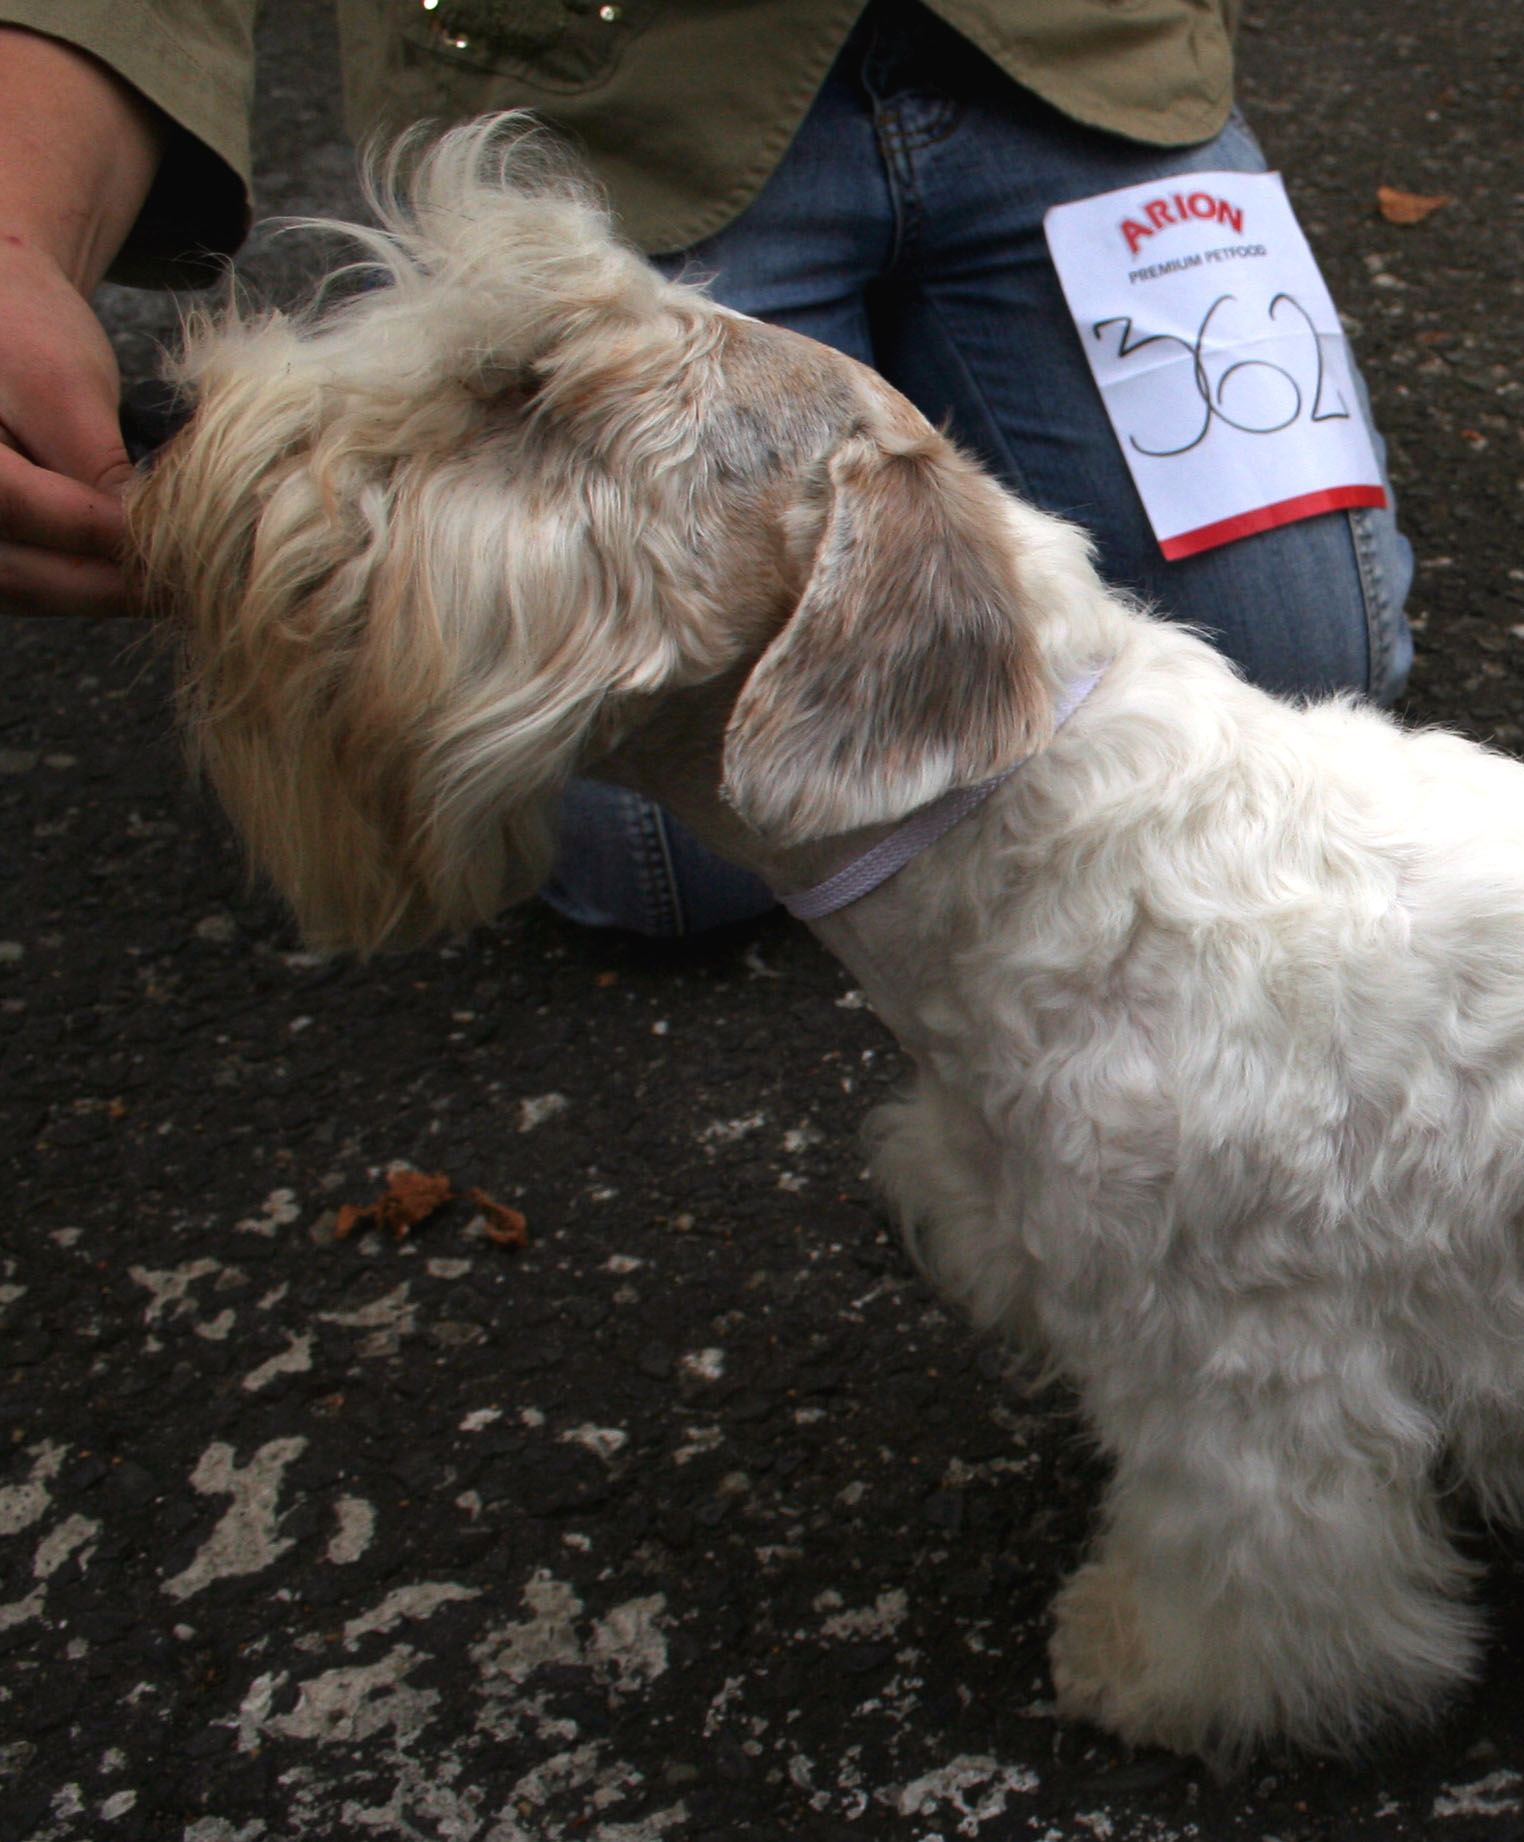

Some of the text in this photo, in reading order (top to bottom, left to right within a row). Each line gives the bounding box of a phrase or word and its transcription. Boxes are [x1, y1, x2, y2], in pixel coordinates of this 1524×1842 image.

[1120, 192, 1244, 254] ARION
[1128, 244, 1268, 284] PREMIUM PETFOOD
[1092, 292, 1350, 457] 362
